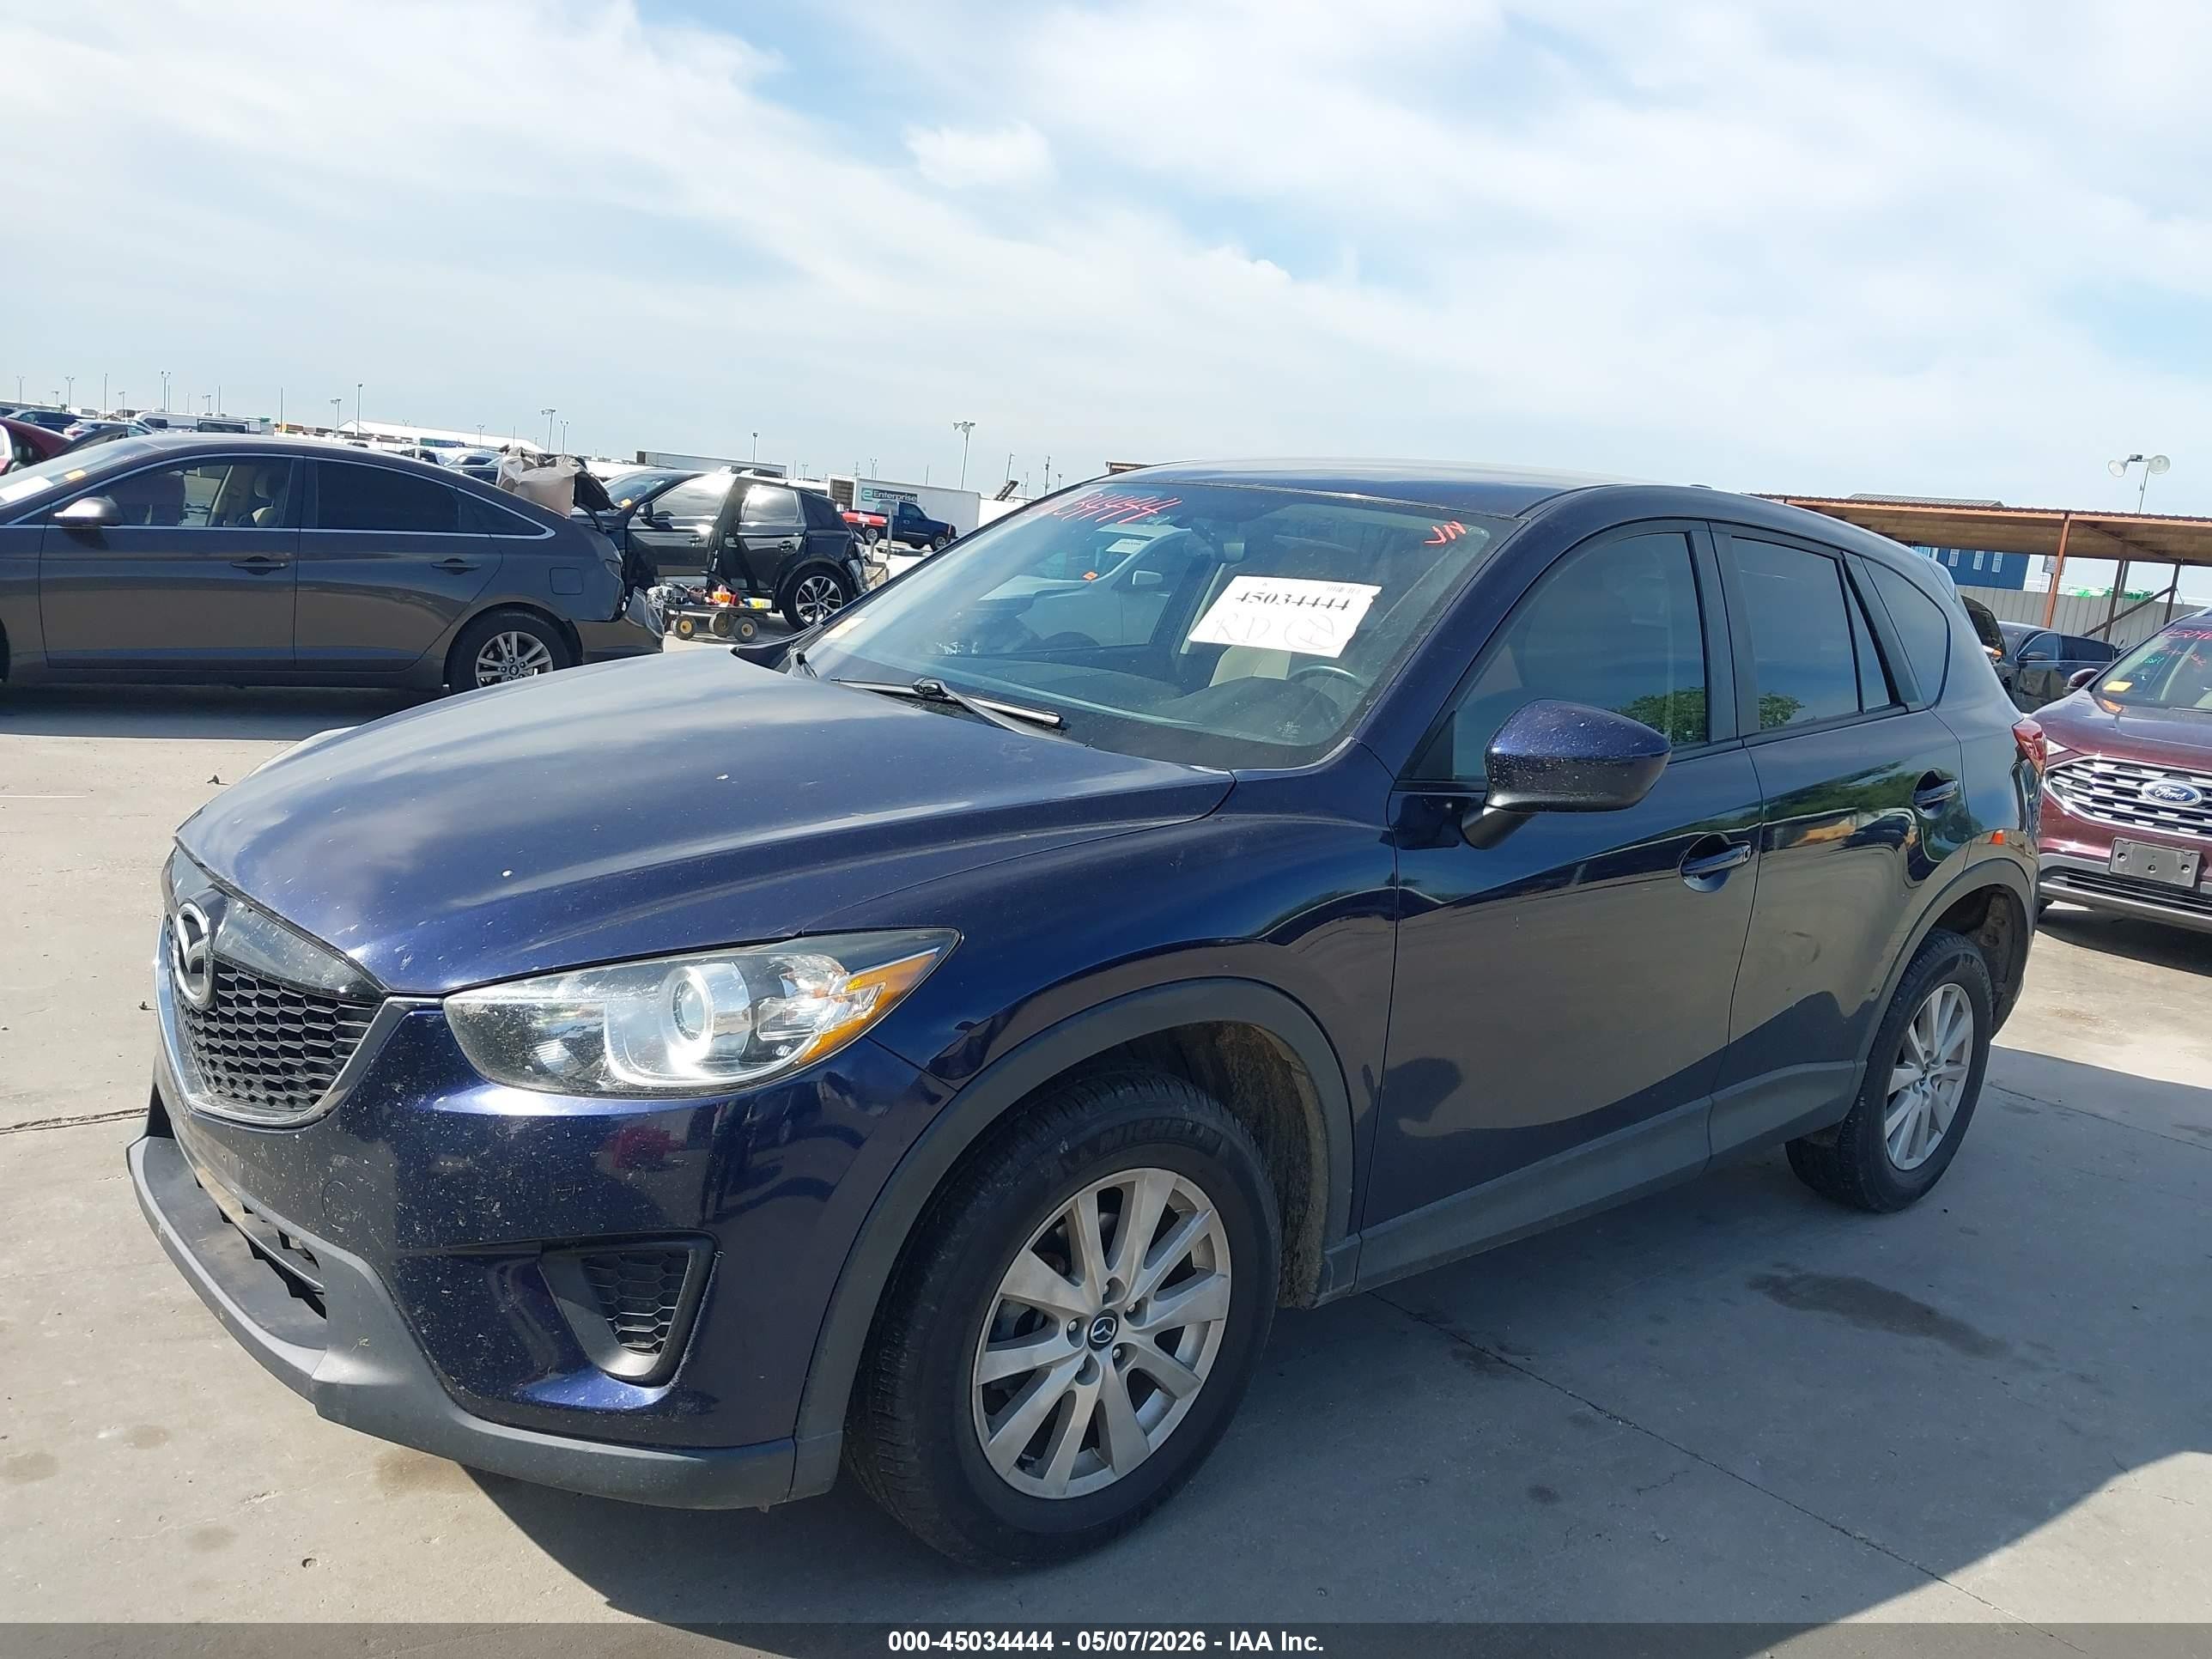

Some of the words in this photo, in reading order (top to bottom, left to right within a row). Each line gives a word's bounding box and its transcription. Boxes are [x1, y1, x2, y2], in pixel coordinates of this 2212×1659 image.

[873, 490, 917, 502] Enterprise
[1236, 591, 1351, 611] 45034444
[2154, 786, 2189, 801] Ford
